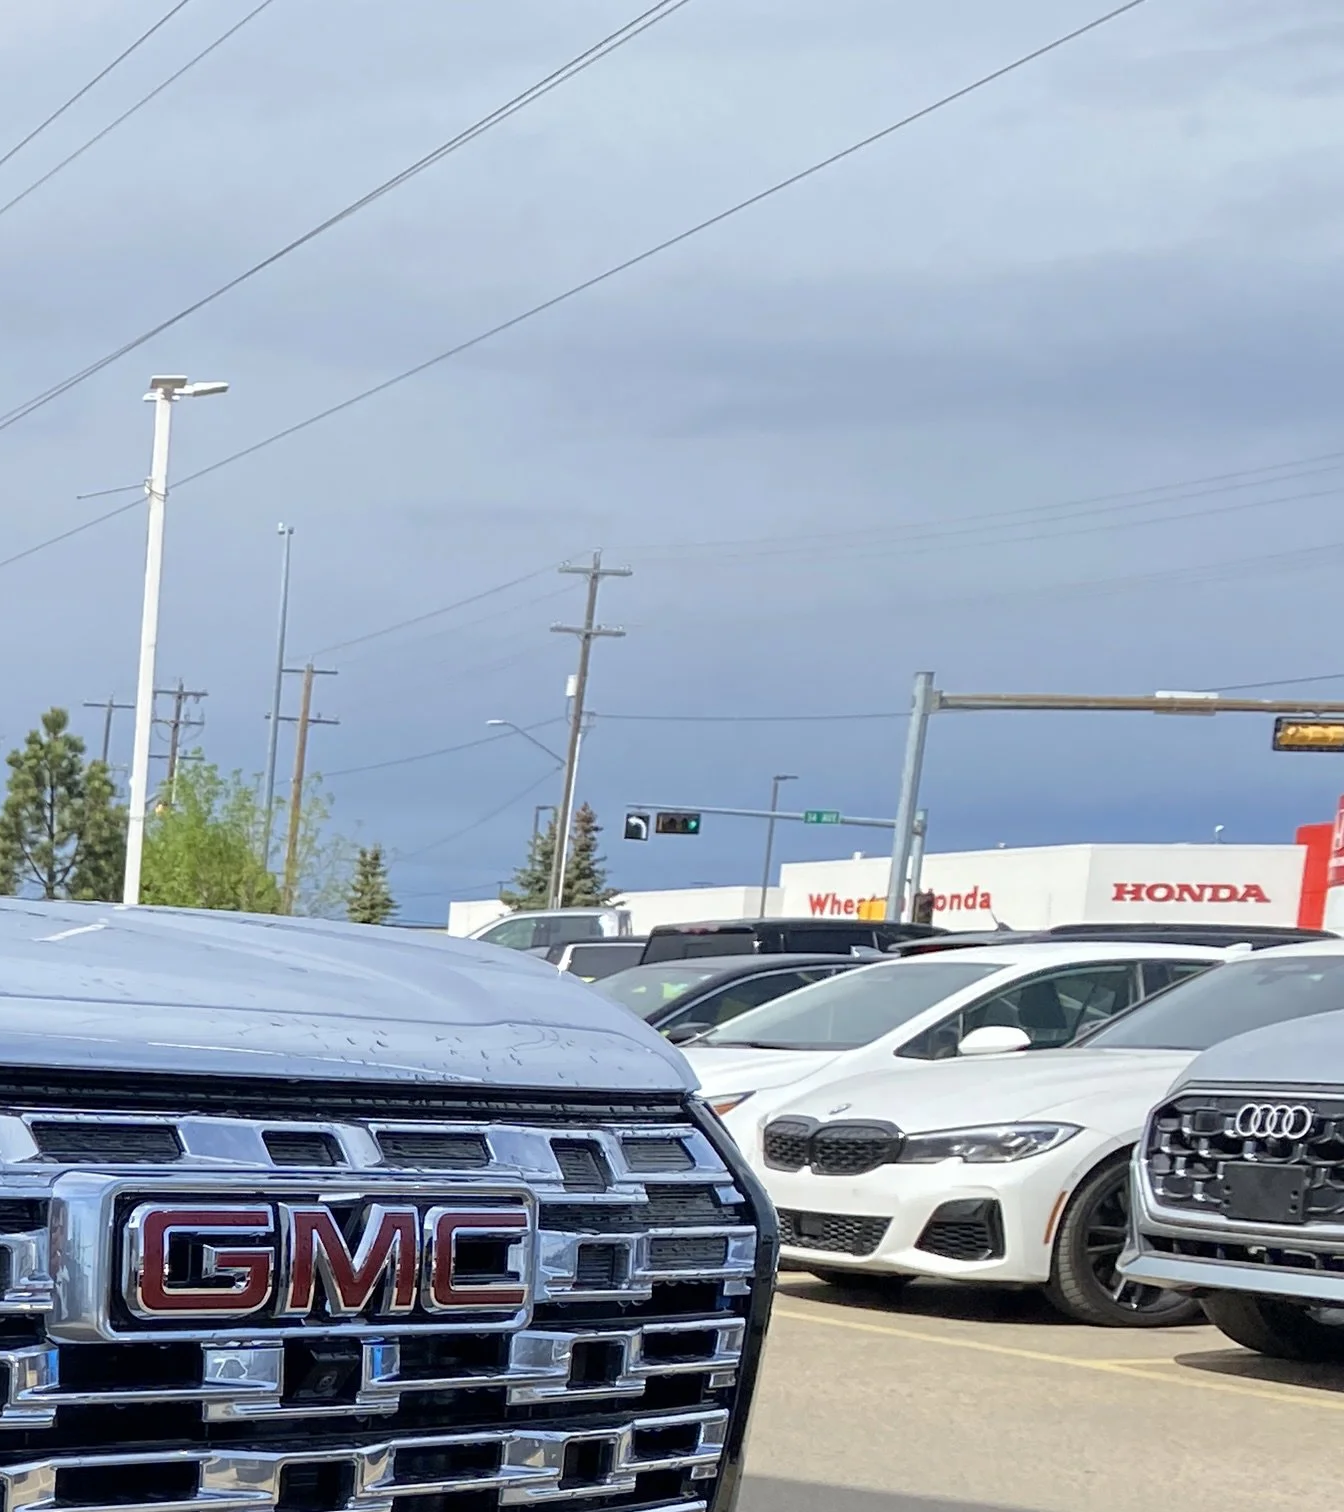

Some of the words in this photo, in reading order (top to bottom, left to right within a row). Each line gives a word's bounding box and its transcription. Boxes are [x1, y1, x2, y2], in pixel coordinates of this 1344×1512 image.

[925, 885, 991, 912] onda
[1112, 883, 1271, 903] HONDA
[123, 1202, 531, 1319] GMC
